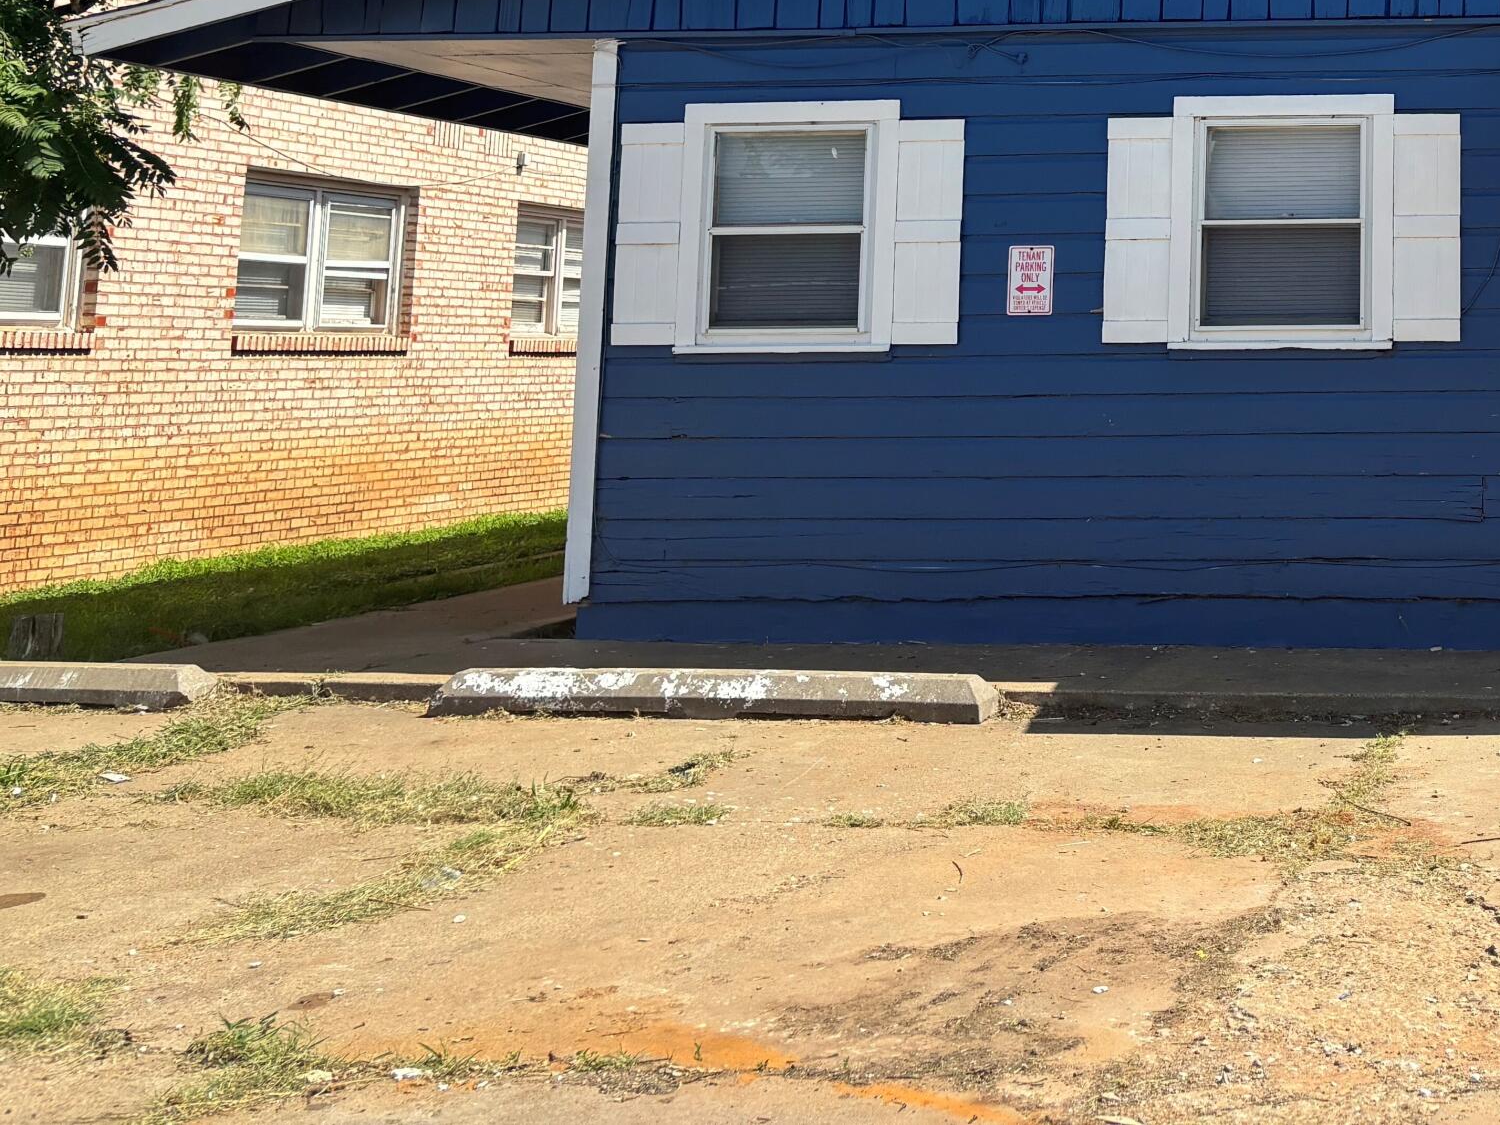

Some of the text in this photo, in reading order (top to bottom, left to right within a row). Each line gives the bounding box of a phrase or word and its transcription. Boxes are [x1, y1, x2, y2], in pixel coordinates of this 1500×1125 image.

[1018, 251, 1045, 261] TENANT
[1015, 262, 1047, 272] PARKING
[1021, 273, 1040, 283] ONLY
